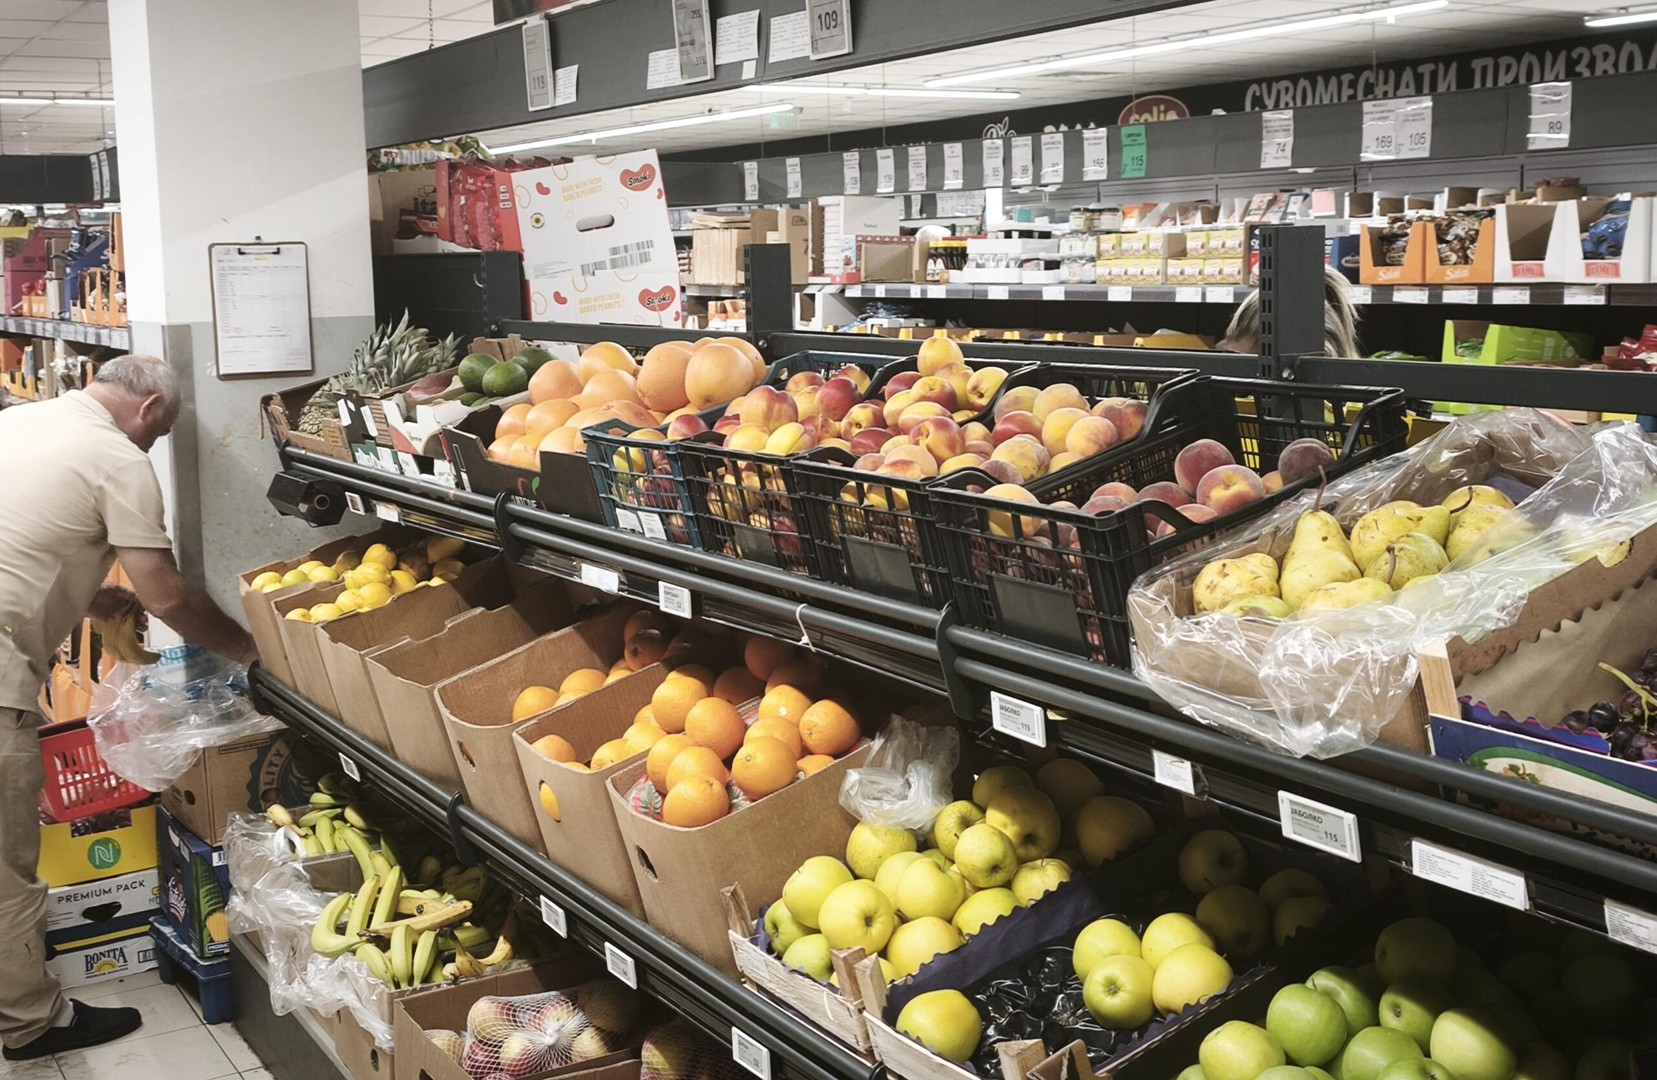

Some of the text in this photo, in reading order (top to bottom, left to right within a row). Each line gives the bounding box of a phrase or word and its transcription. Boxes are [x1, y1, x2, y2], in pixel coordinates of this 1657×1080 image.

[818, 10, 838, 32] 109
[532, 75, 545, 91] 119
[1548, 120, 1562, 134] 89
[1375, 134, 1393, 149] 169
[1408, 131, 1427, 146] 105
[1275, 142, 1287, 155] 74
[1131, 154, 1144, 166] 115
[628, 171, 651, 187] Smoki
[1021, 722, 1031, 731] 115
[1290, 807, 1323, 825] ЈАБОЛКО
[1324, 830, 1338, 843] 115
[58, 879, 146, 904] PREMIUM PACK
[84, 946, 128, 973] BONITA
